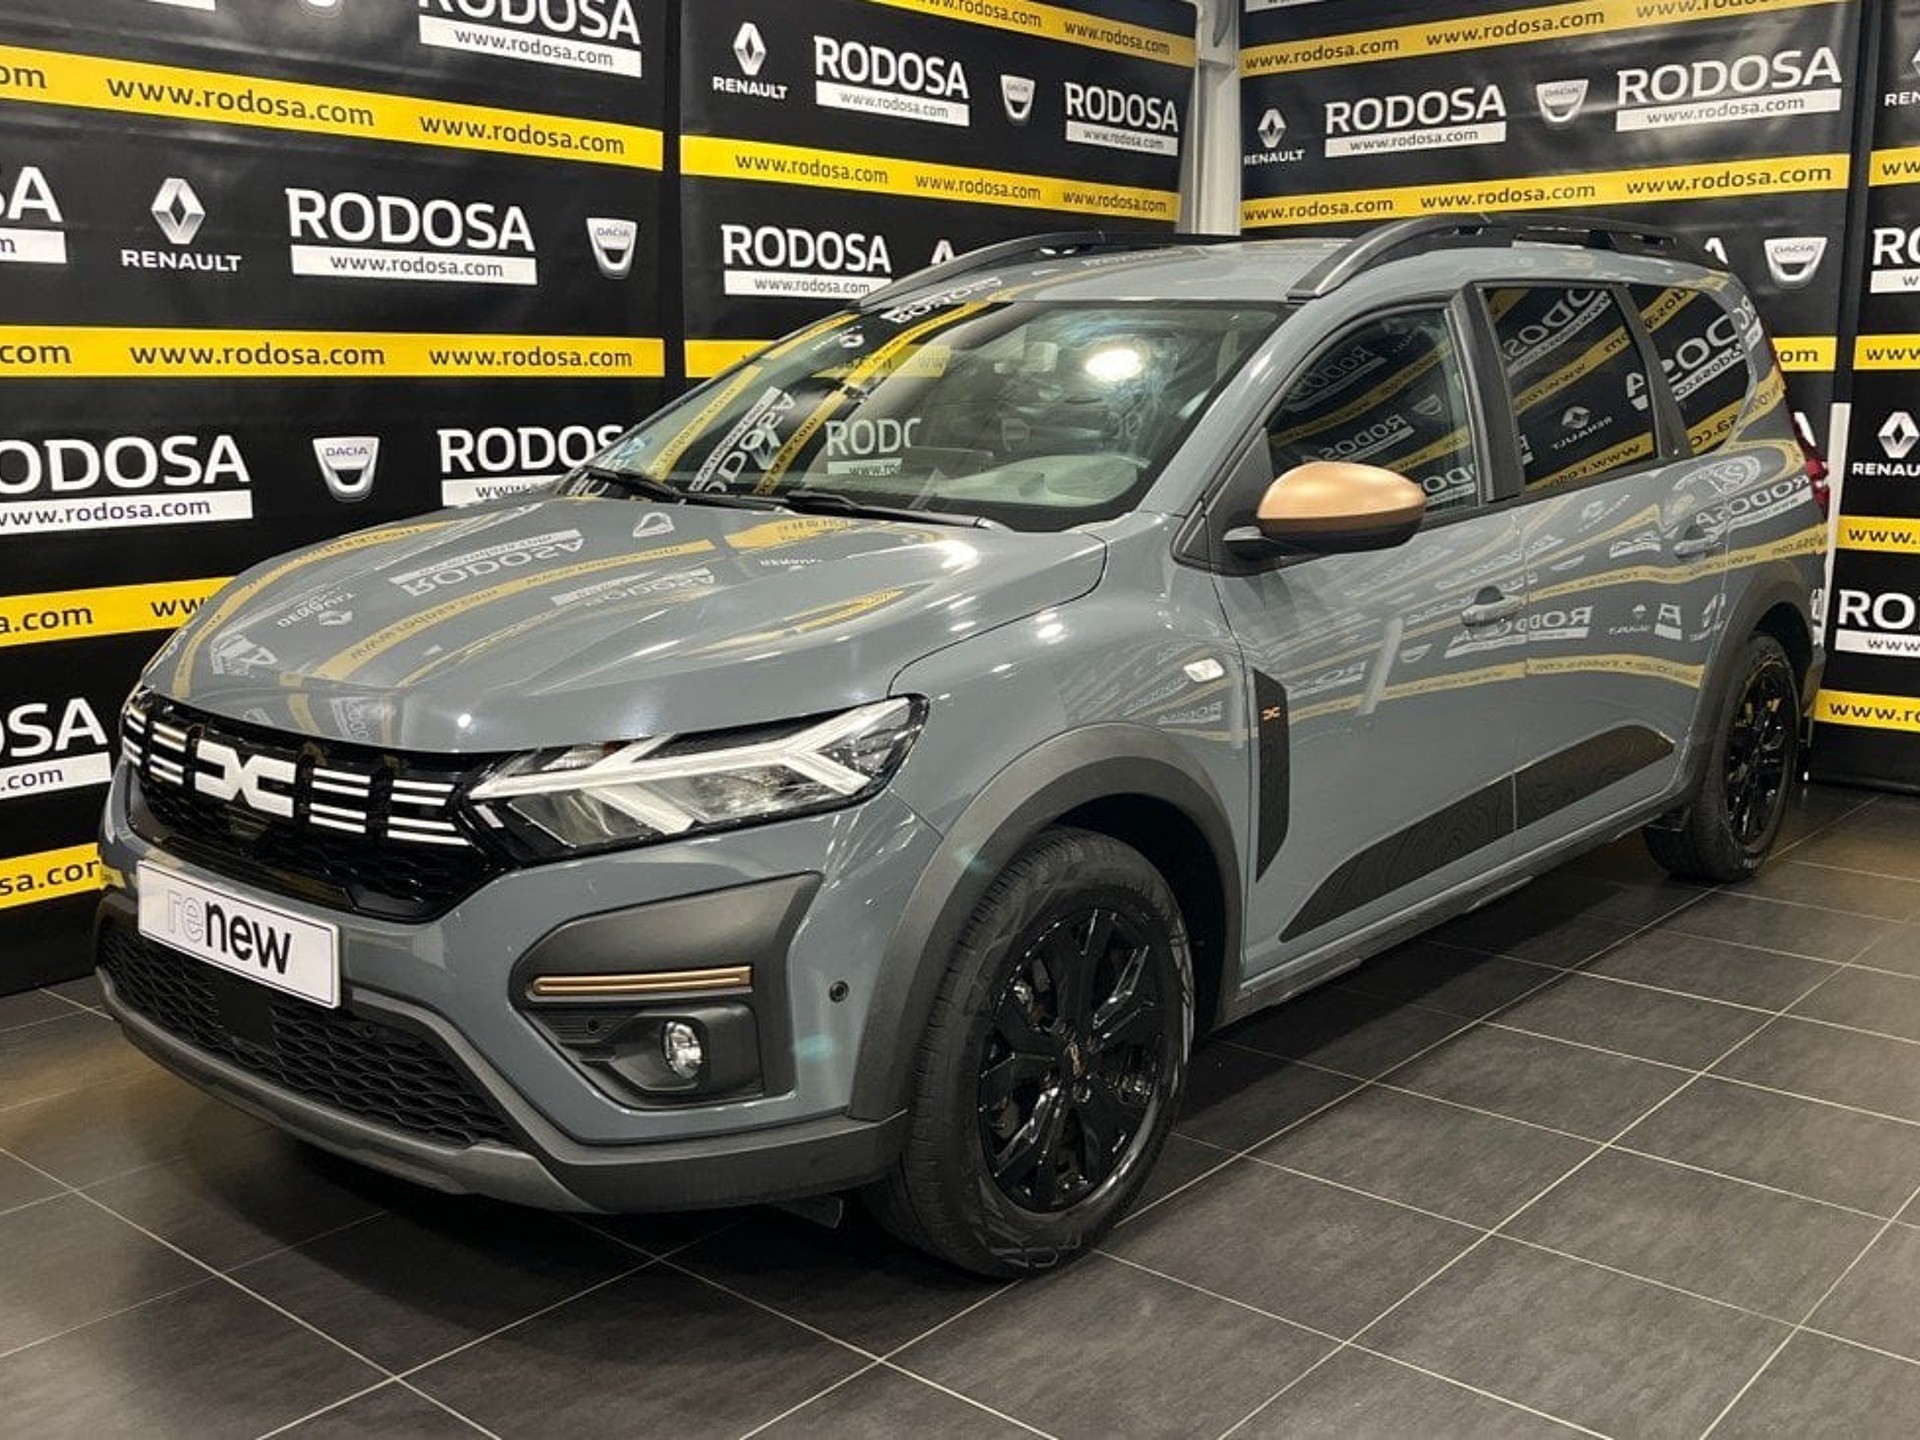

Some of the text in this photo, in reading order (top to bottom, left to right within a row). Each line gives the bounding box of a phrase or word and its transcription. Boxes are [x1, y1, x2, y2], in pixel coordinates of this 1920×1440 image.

[418, 0, 641, 44] DOSA
[1426, 10, 1605, 46] www.rodosa.com
[454, 29, 613, 66] www.rodosa.com
[1065, 21, 1170, 55] www.rodosa.com
[813, 35, 970, 99] RODOSA
[1245, 38, 1399, 70] www.rodosa.com
[712, 76, 788, 99] RENAULT
[1617, 47, 1842, 105] RODOSA
[106, 78, 374, 126] www.rodosa.com
[840, 92, 949, 119] www.rodosa.com
[1064, 82, 1179, 133] RODOSA
[1325, 84, 1506, 135] RODOSA
[1646, 97, 1805, 124] www.rodosa.com
[420, 115, 625, 154] www.rodosa.com
[1083, 127, 1164, 150] www.rodosa.com
[1349, 129, 1479, 153] www.rodosa.com
[735, 155, 888, 184] www.rodosa.com
[1244, 149, 1305, 166] RENAULT
[915, 173, 1041, 201] www.rodosa.com
[1626, 166, 1831, 195] www.rodosa.com
[1062, 190, 1167, 213] www.rodosa.com
[1244, 197, 1393, 221] www.rodosa.com
[1420, 184, 1596, 209] www.rodosa.com
[285, 187, 536, 252] RODOSA
[121, 249, 242, 272] RENAULT
[721, 224, 892, 273] RODOSA
[331, 254, 503, 277] www.rodosa.com
[754, 277, 870, 294] www.rodosa.com
[130, 342, 385, 365] www.rodosa.com
[429, 346, 632, 367] www.rodosa.com
[325, 446, 368, 457] DACIA
[437, 425, 623, 472] RODOS
[0, 435, 249, 494] ODOSA
[1852, 462, 1920, 477] RENAU
[167, 890, 291, 975] renew
